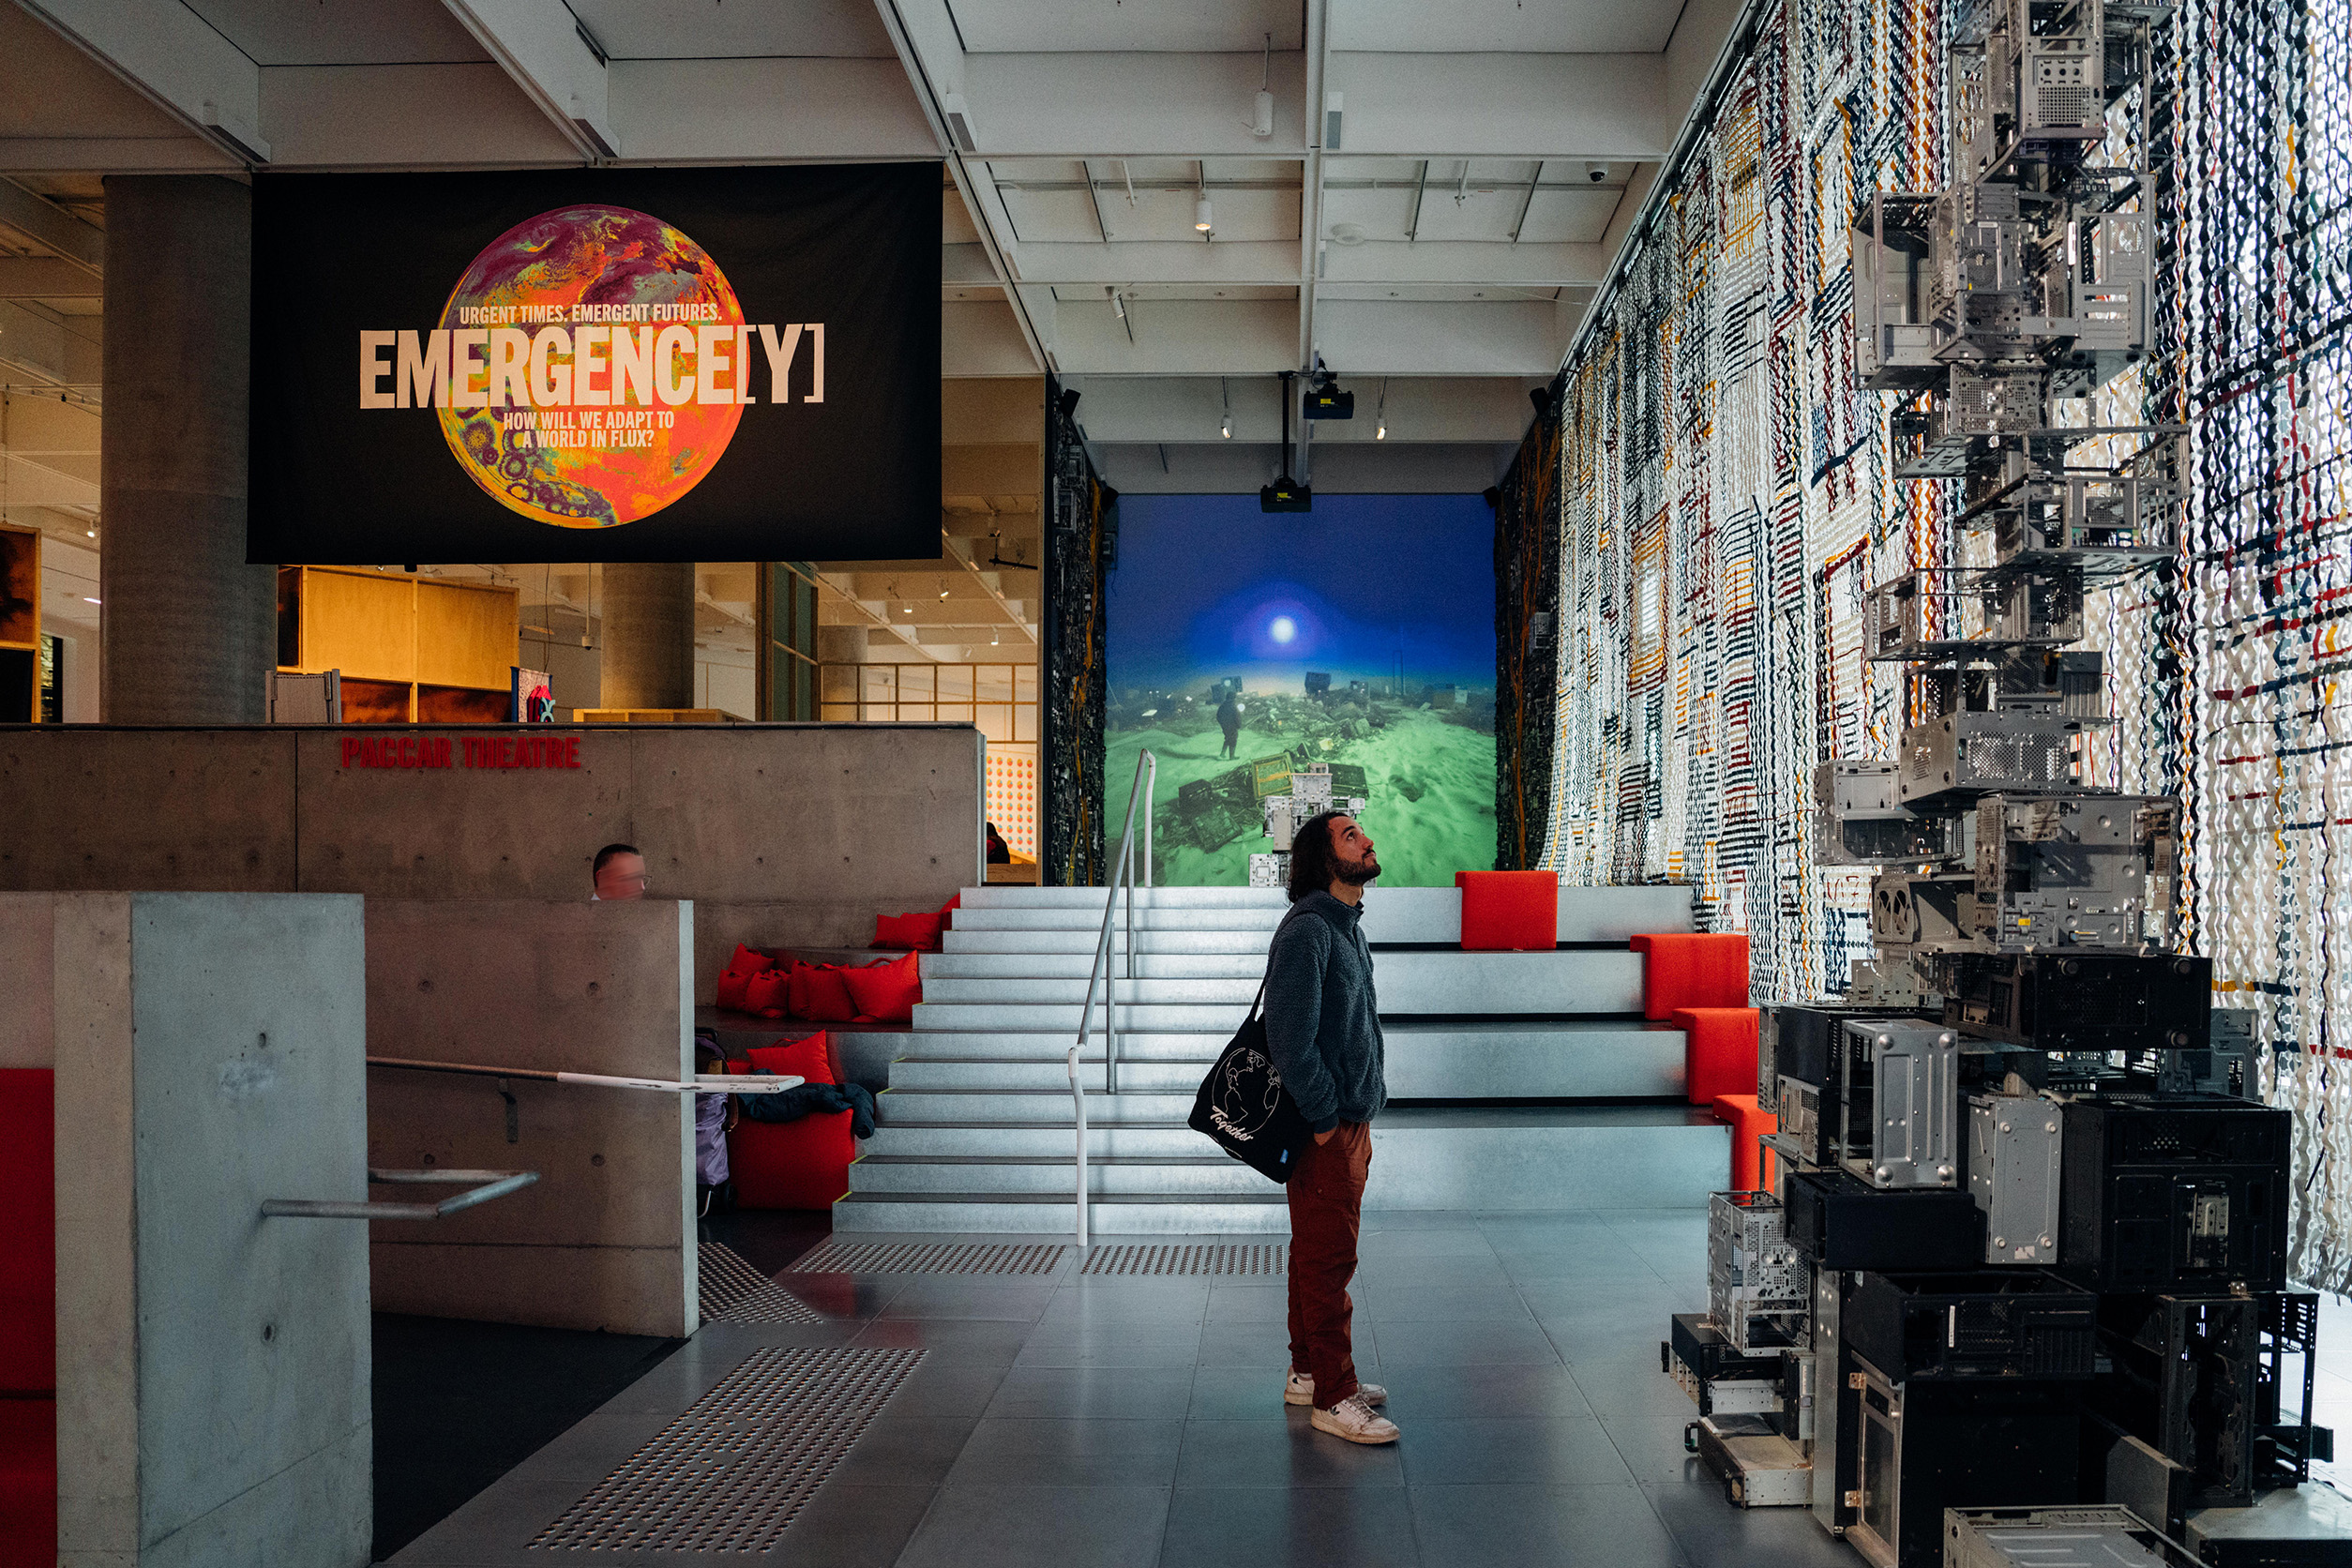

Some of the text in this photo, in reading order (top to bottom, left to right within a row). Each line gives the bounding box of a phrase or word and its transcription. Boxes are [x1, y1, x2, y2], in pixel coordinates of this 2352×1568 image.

[460, 303, 723, 324] URGENT TIMES. EMERGENT FUTURES.
[360, 323, 825, 409] EMERGENCE[Y]
[504, 411, 674, 430] HOW WILL WE ADAPT TO
[522, 430, 655, 447] A WORLD IN FLUX?
[341, 736, 581, 768] PACCAR THEATRE
[1210, 1105, 1254, 1141] Together
